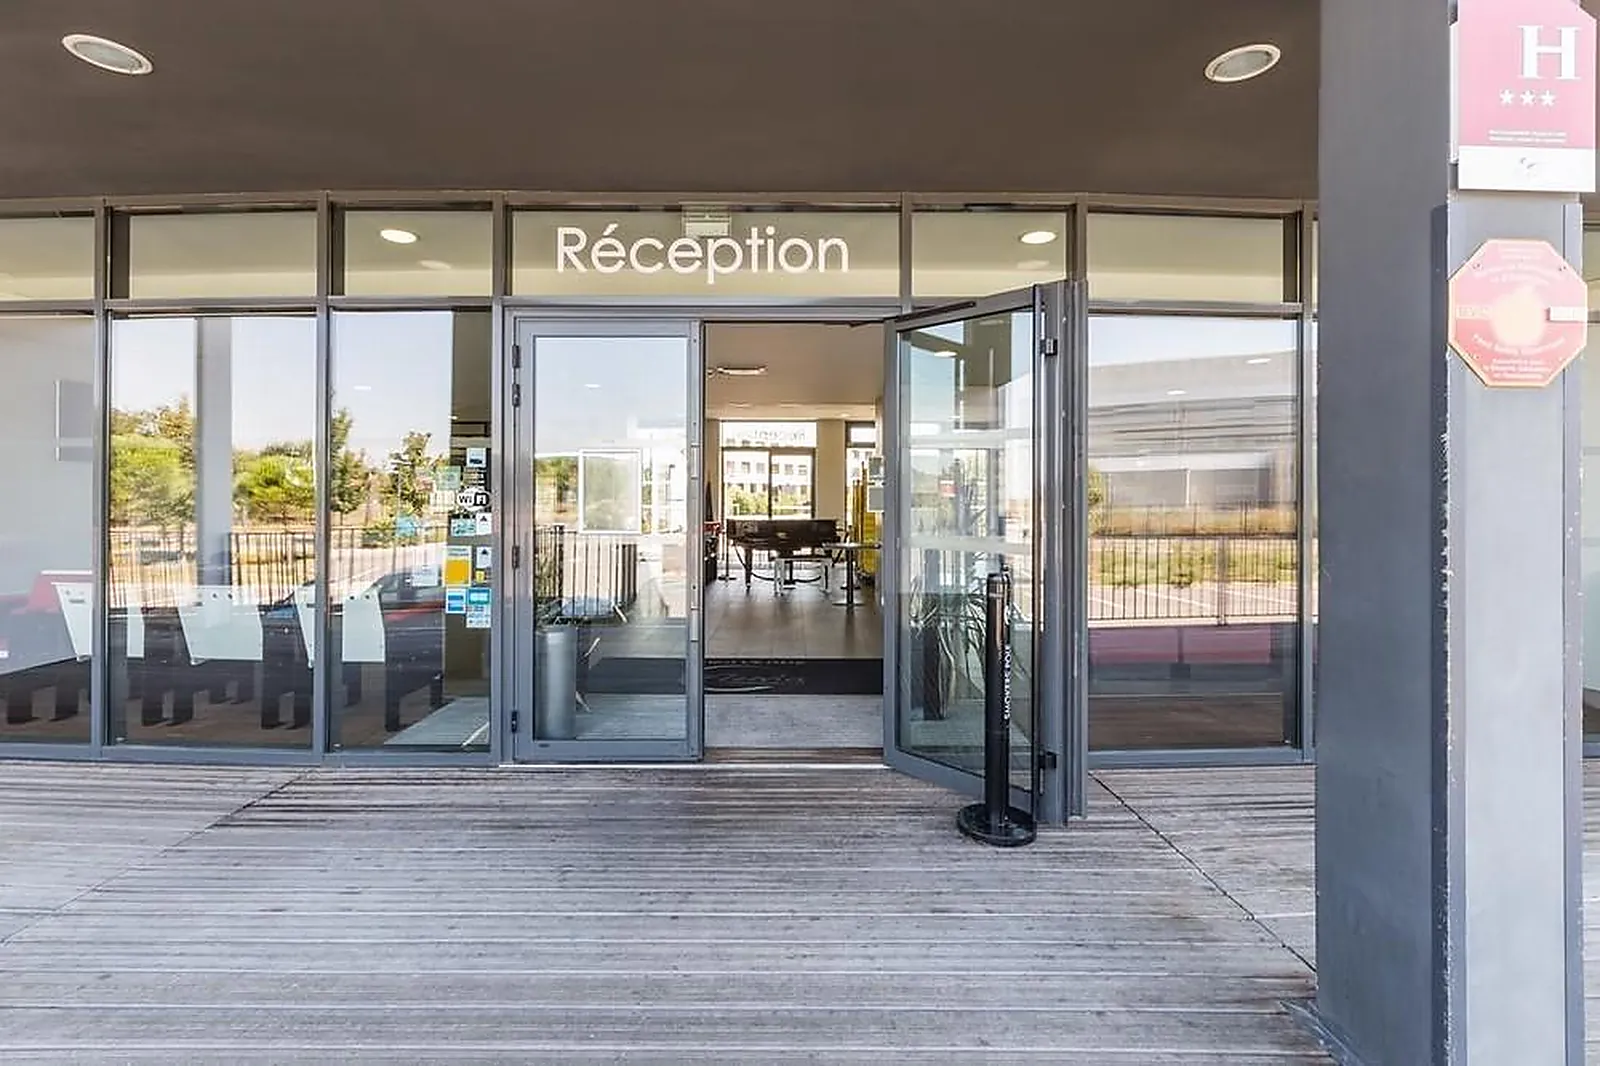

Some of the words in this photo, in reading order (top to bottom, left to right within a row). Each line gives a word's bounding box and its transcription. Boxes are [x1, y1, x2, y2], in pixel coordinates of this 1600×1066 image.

[1517, 25, 1581, 80] H
[556, 223, 850, 285] Réception
[1003, 644, 1012, 669] POLE
[1003, 671, 1012, 720] SMOKERS
